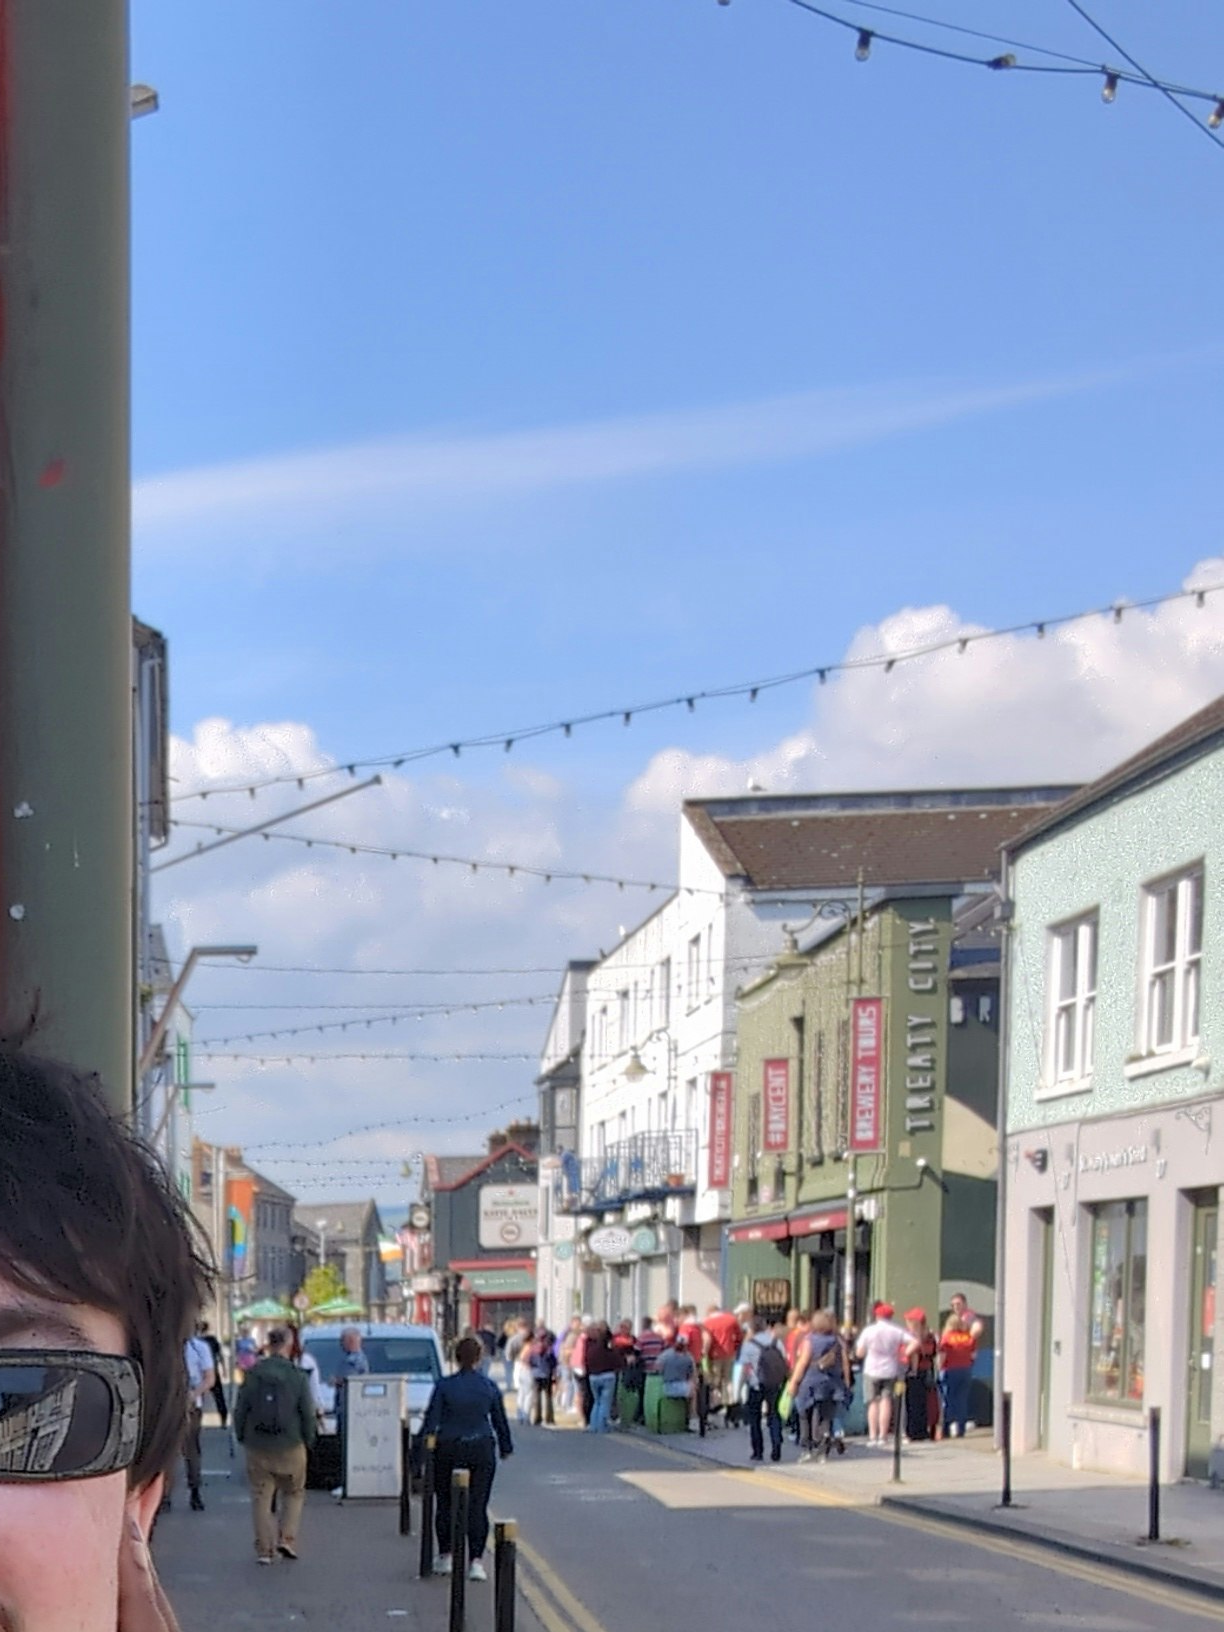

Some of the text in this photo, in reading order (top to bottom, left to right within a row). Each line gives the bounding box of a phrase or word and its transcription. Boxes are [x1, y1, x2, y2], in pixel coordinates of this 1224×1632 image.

[856, 1006, 877, 1141] BREWERY TOURS
[906, 921, 934, 1132] TREATY CITY
